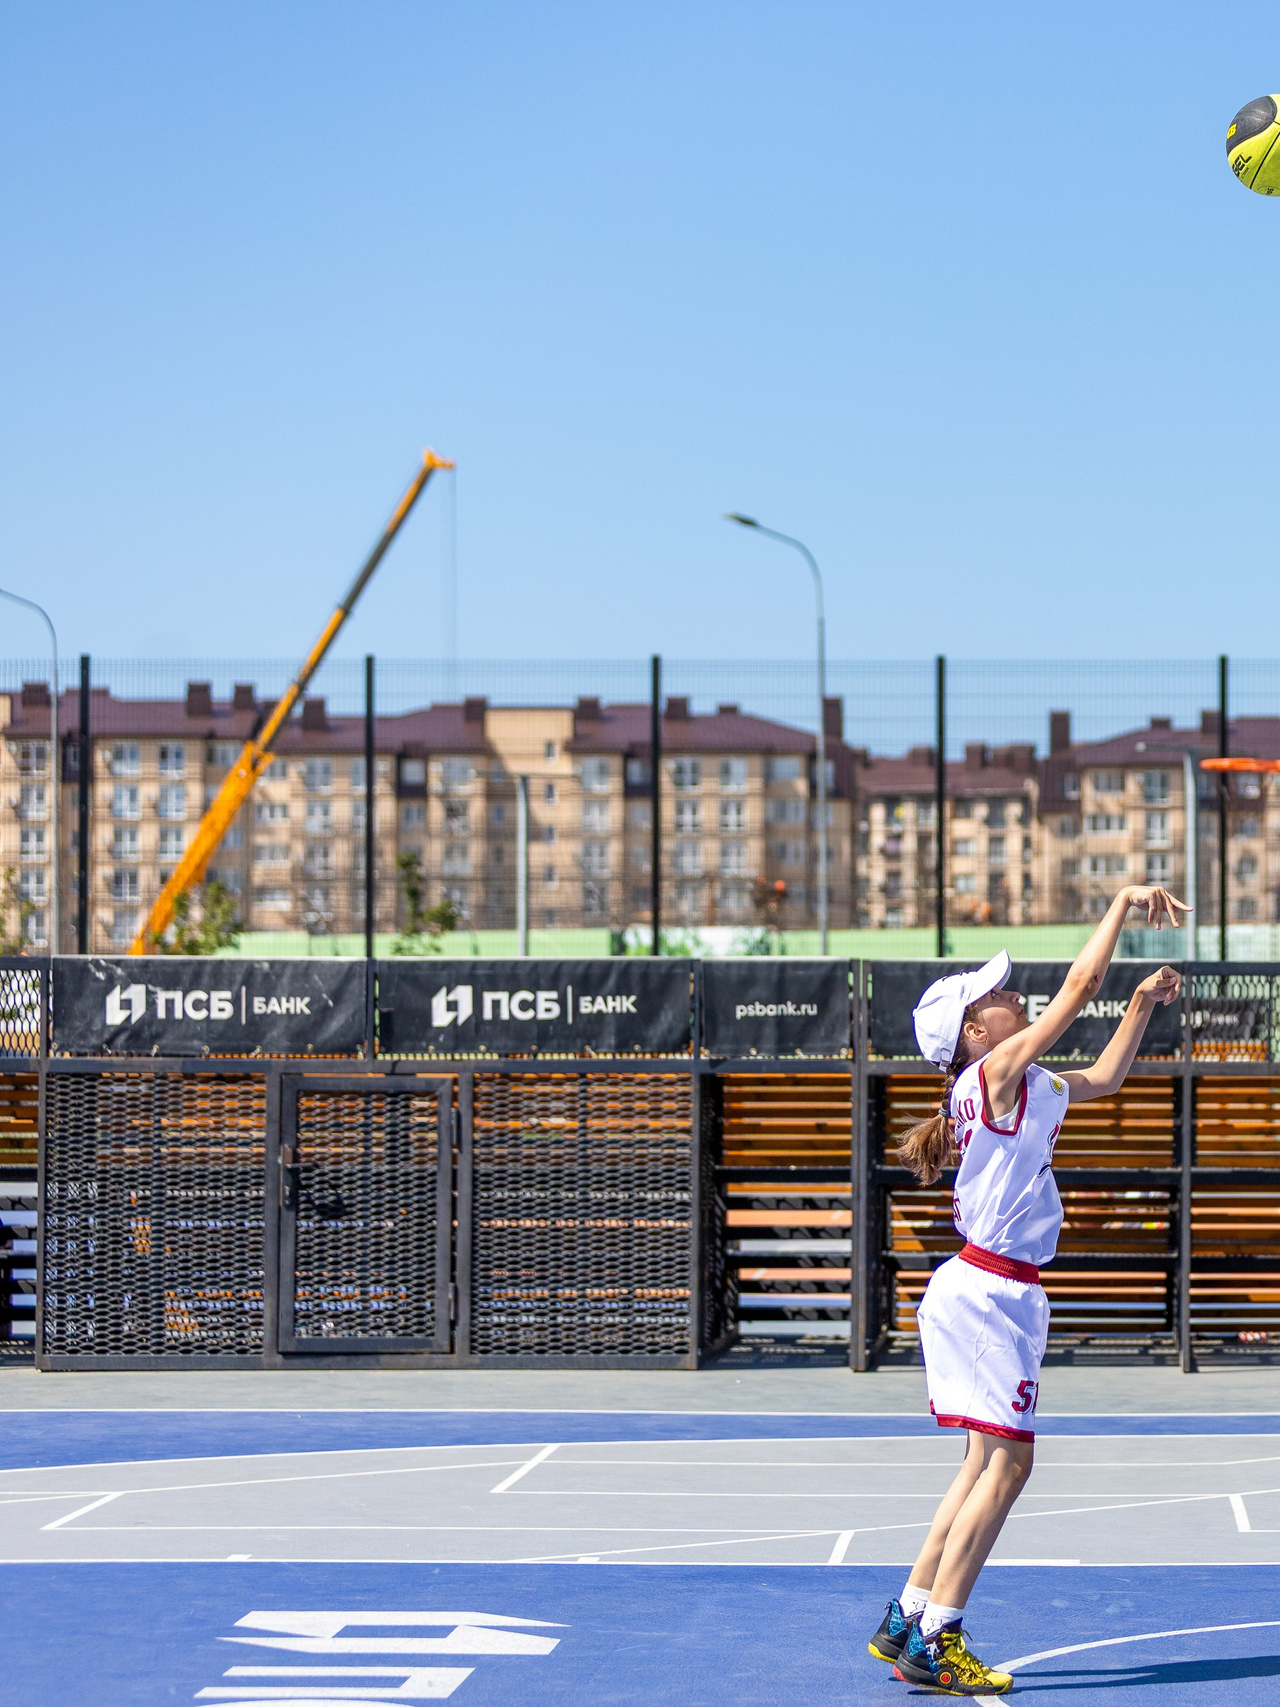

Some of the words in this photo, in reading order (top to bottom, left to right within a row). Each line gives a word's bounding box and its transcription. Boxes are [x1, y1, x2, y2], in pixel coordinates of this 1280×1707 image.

[156, 990, 234, 1020] ПСБ
[253, 996, 311, 1015] БАНК
[482, 990, 561, 1021] ПСБ
[579, 995, 637, 1014] БАНК
[735, 1000, 818, 1020] psbank.ru
